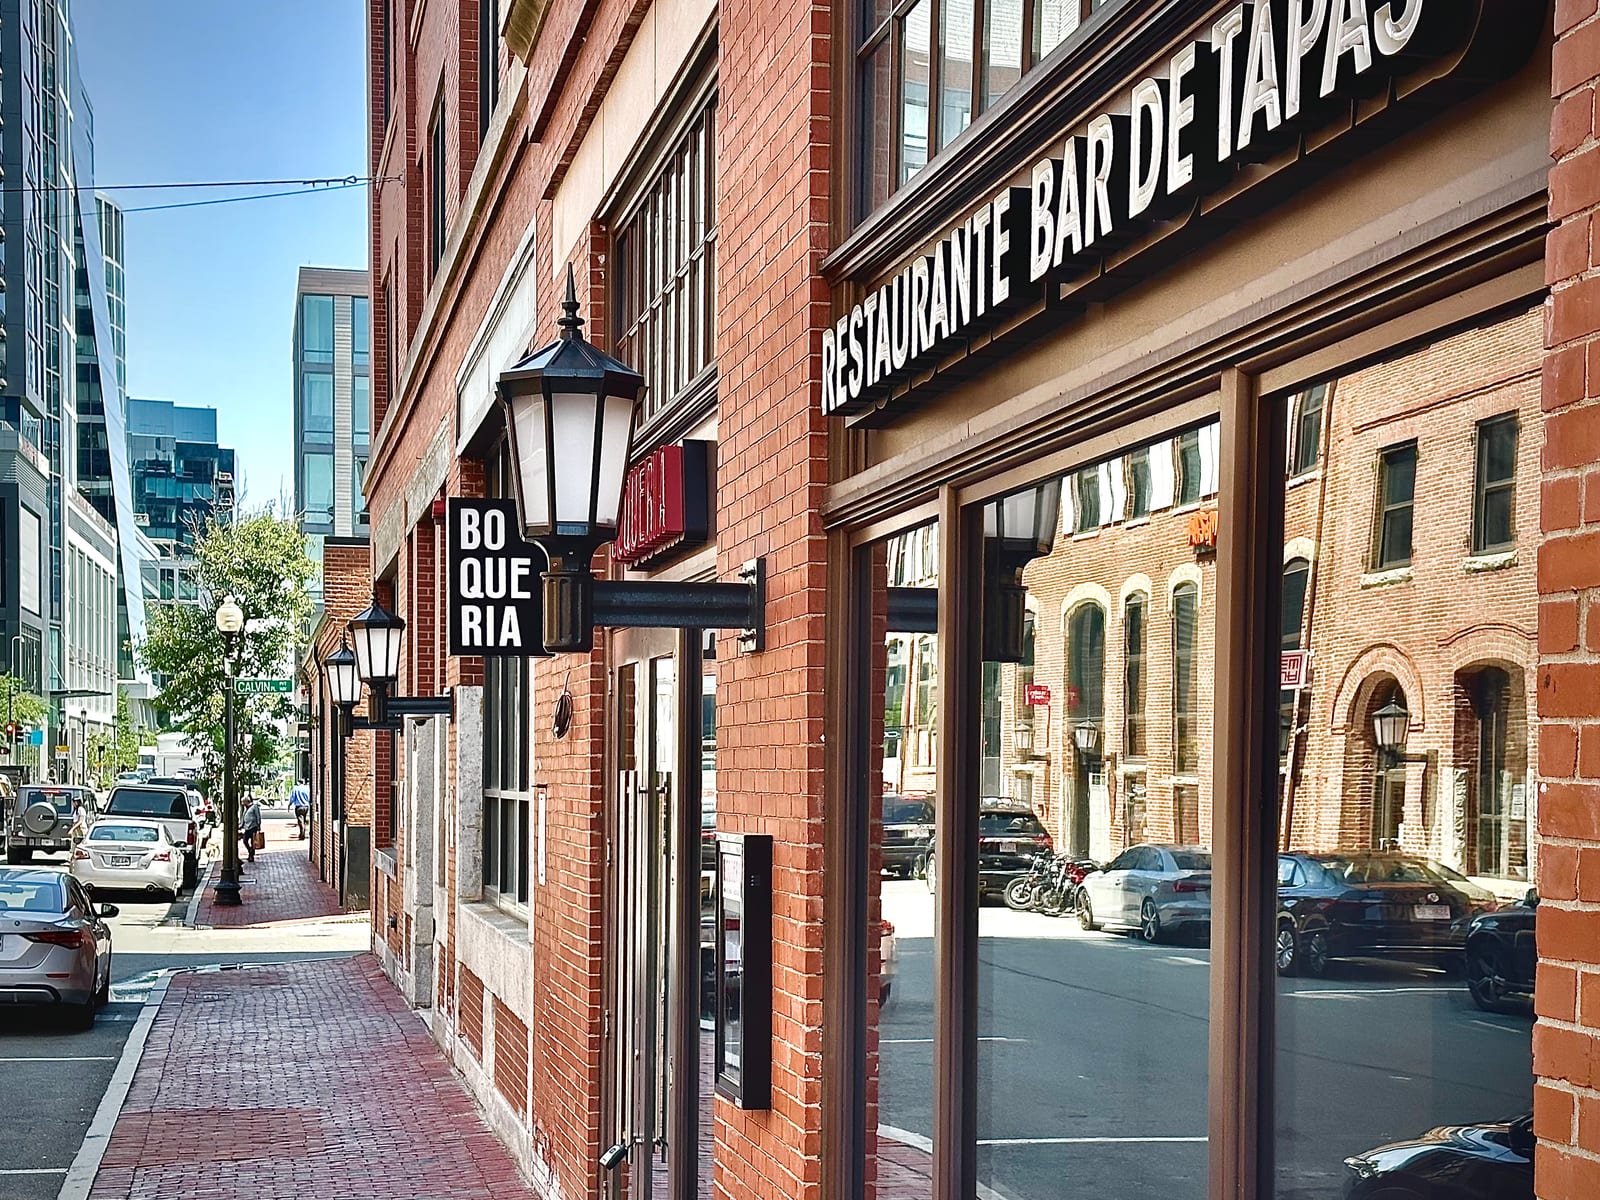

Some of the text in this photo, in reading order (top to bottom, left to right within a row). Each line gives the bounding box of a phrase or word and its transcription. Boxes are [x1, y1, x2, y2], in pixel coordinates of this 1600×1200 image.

[822, 187, 1010, 416] RESTAURANTE
[1030, 113, 1114, 283] BAR
[1129, 40, 1196, 220] DE
[460, 508, 505, 550] BO
[460, 557, 531, 599] QUE
[461, 605, 522, 647] RIA
[237, 681, 270, 692] CALVIN
